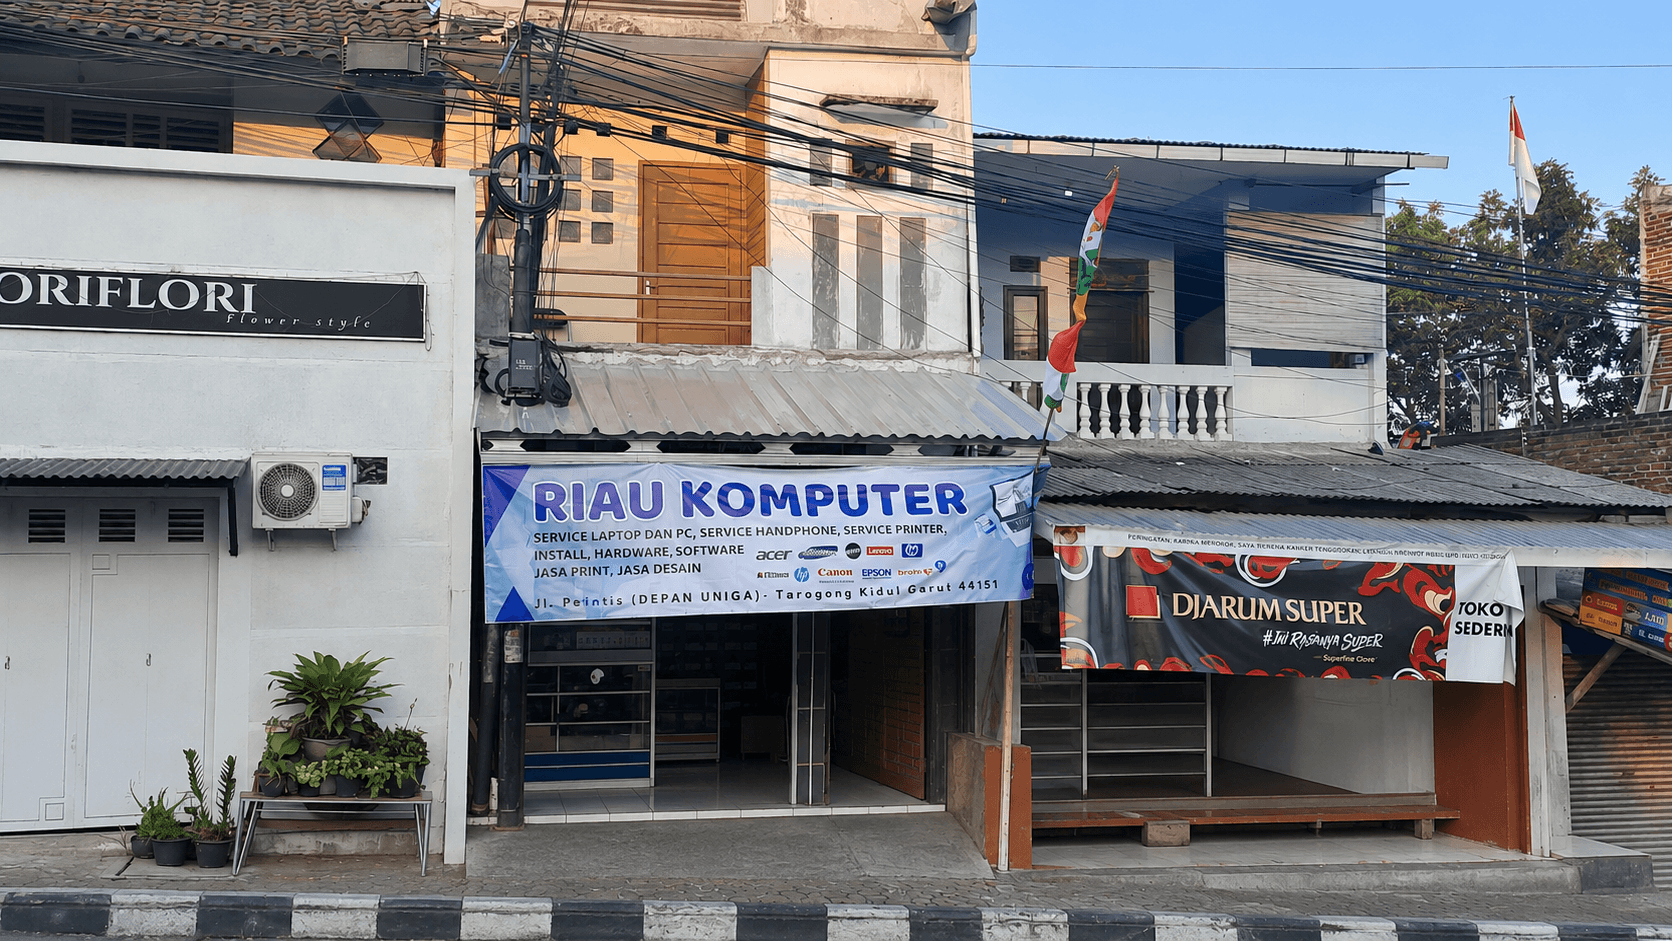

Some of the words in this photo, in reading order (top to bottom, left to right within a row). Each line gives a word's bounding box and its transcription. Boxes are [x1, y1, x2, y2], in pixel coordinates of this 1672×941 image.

[534, 481, 665, 523] RIAU
[680, 480, 969, 519] KOMPUTER
[534, 531, 588, 543] SERVICE
[591, 530, 641, 542] LAPTOP
[645, 529, 673, 539] DAN
[676, 528, 696, 540] PC,
[700, 527, 752, 538] SERVICE
[756, 525, 840, 537] HANDPHONE,
[844, 525, 892, 535] SERVICE
[895, 524, 948, 536] PRINTER,
[534, 550, 591, 561] INSTALL,
[594, 547, 673, 559] HARDWARE,
[676, 545, 745, 556] SOFTWARE
[756, 549, 792, 560] acer
[534, 567, 567, 578] JASA
[571, 566, 614, 577] PRINT,
[617, 564, 650, 575] JASA
[653, 563, 701, 574] DESAIN
[818, 568, 853, 576] Canon
[862, 568, 892, 577] EPSON
[534, 598, 553, 609] Jl.
[632, 592, 692, 606] (DEPAN
[776, 589, 852, 600] Tarogong
[859, 586, 900, 597] Kidul
[908, 583, 952, 594] Garut
[958, 579, 999, 591] 44151
[1172, 592, 1282, 621] DJARUM
[1286, 598, 1367, 625] SUPER
[1458, 601, 1504, 617] TOKO
